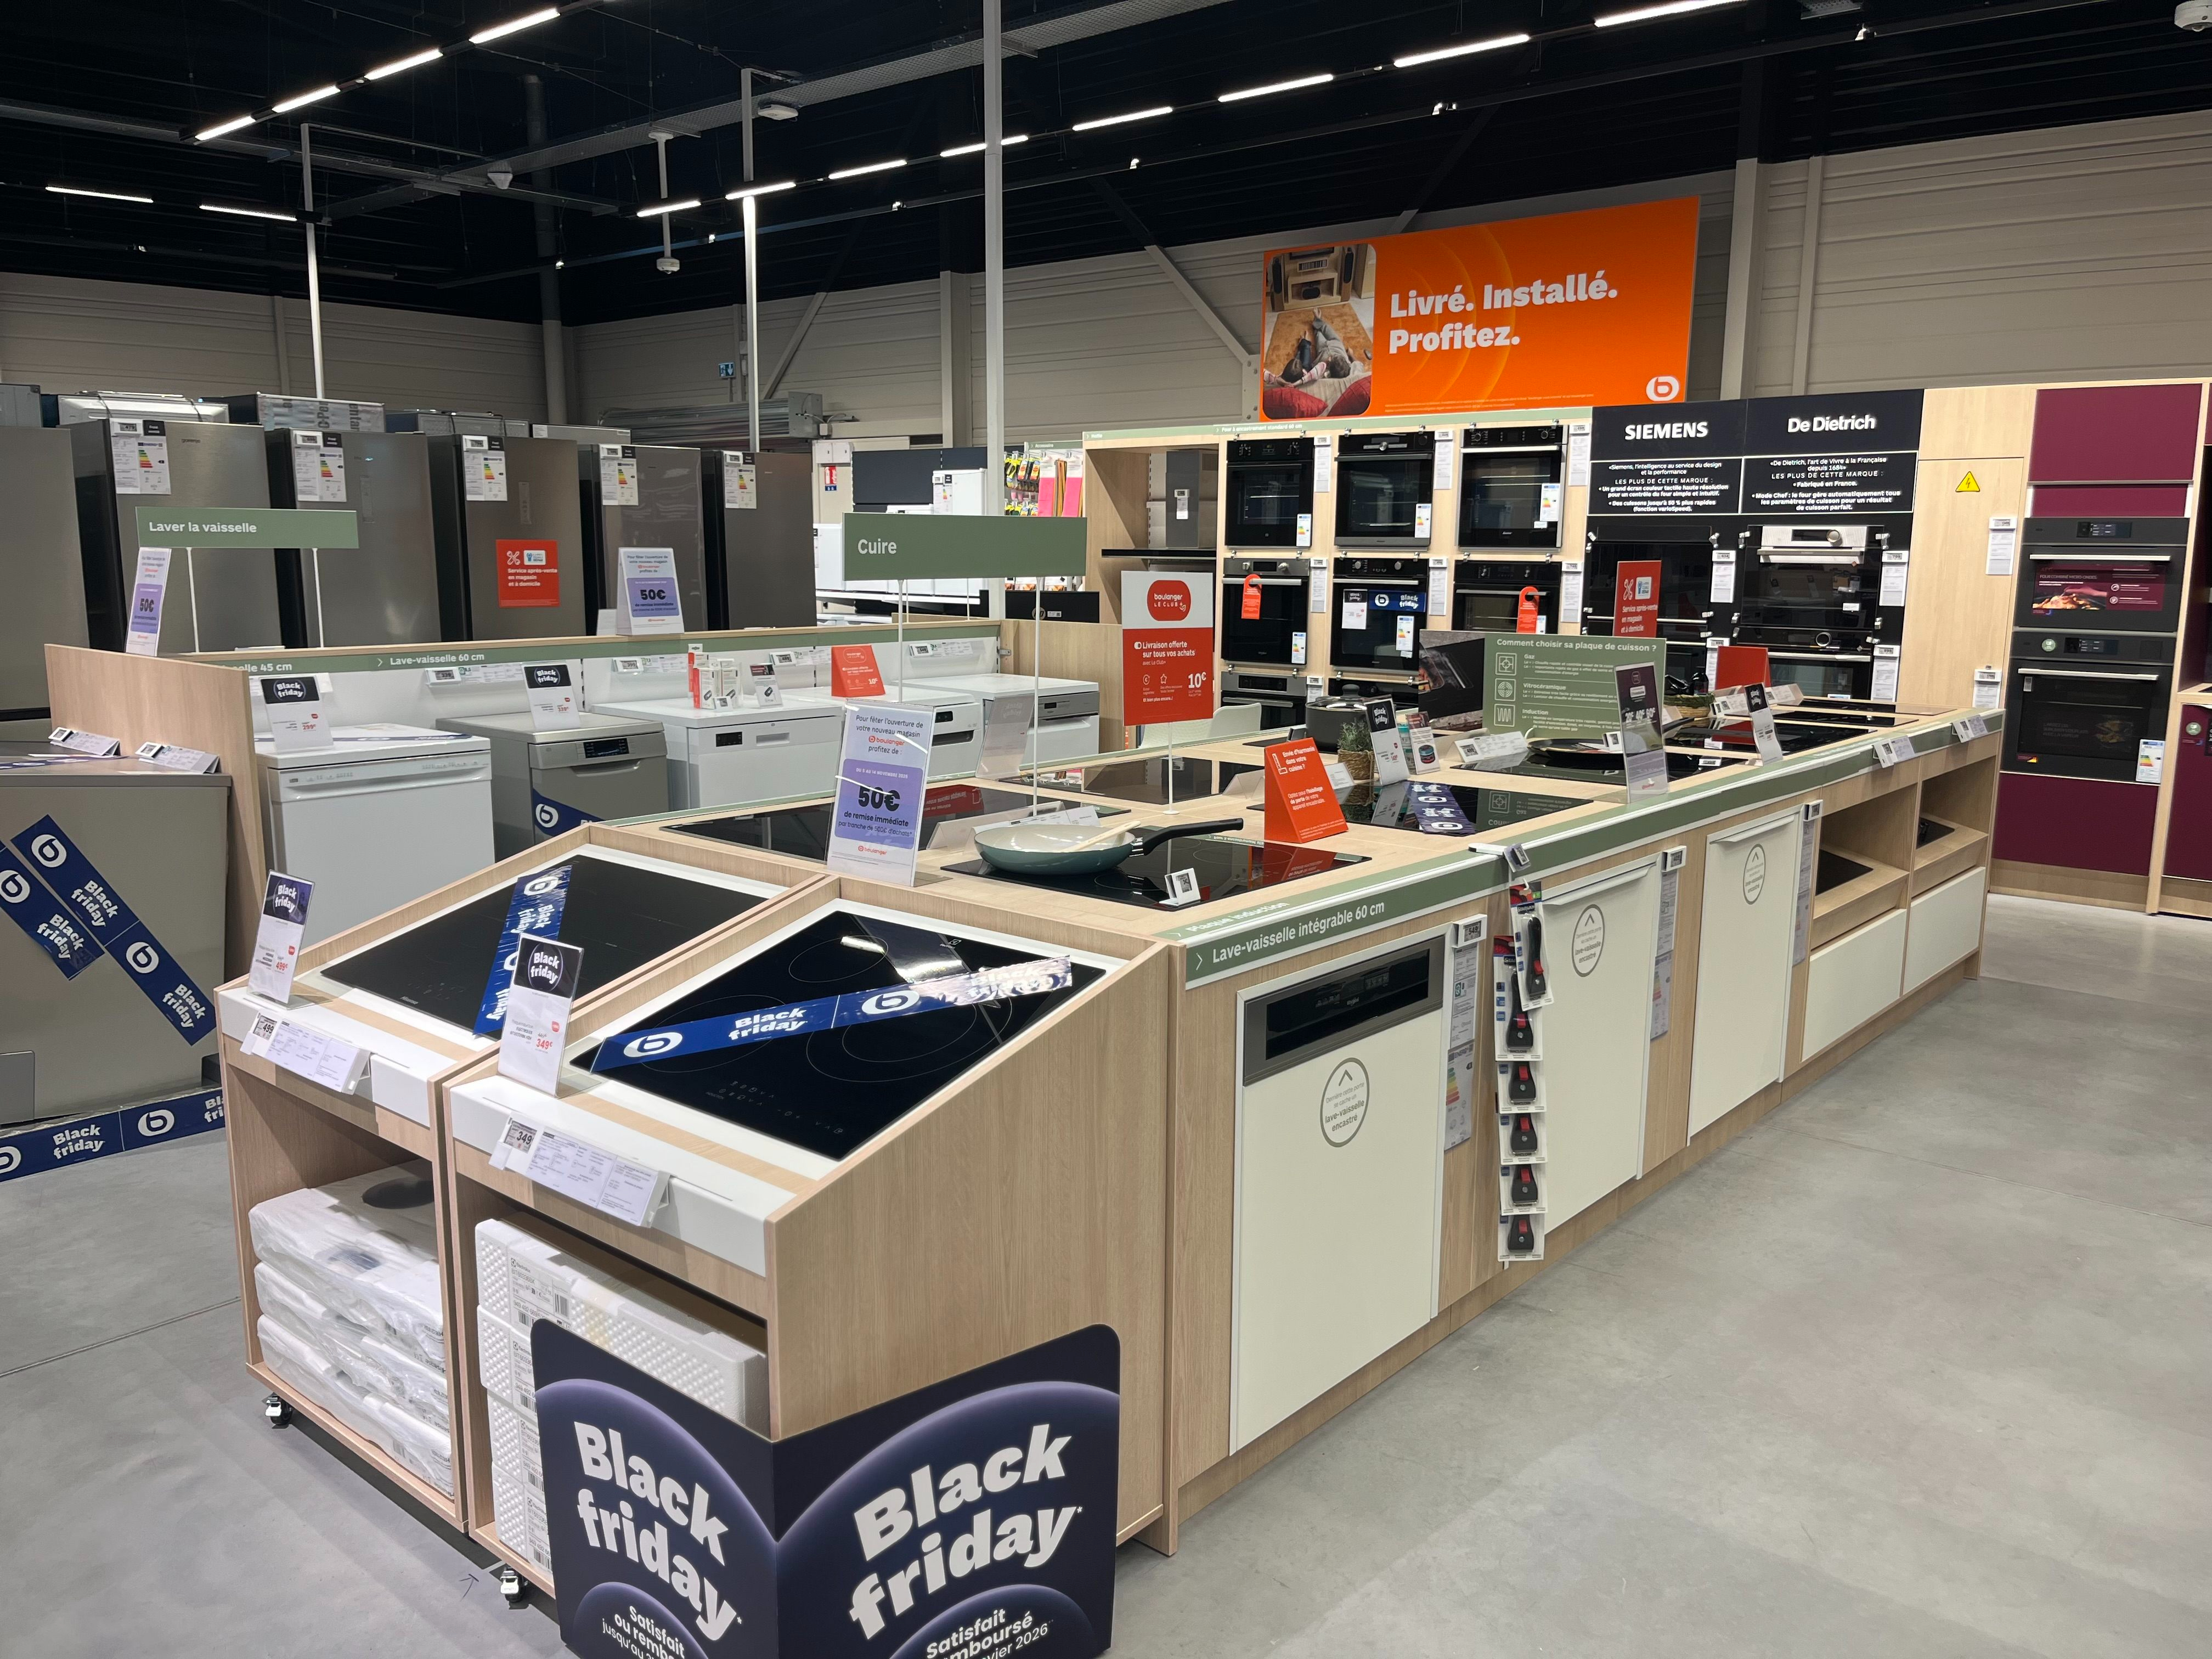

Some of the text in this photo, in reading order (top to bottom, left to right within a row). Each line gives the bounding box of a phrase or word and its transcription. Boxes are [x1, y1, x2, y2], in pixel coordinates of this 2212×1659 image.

[1391, 270, 1618, 318] Livré. Installé.
[1389, 323, 1520, 354] Profitez.
[1624, 422, 1708, 440] SIEMENS
[1787, 415, 1876, 433] De Dietrich
[149, 521, 257, 533] Laver la vaisselle
[857, 538, 897, 555] Cuire
[640, 589, 666, 600] 50€
[140, 599, 154, 612] 50€
[1575, 642, 1602, 650] plaque
[390, 655, 456, 665] Lave-vaisselle
[459, 653, 471, 662] 60
[1188, 672, 1206, 689] 10€
[885, 718, 915, 727] l'ouverture
[897, 729, 920, 737] magasin
[868, 746, 890, 754] profitez
[1294, 746, 1315, 755] d'harmonie
[858, 786, 900, 812] 50€
[848, 822, 866, 830] tranche
[853, 813, 873, 821] remise
[874, 814, 909, 827] immédiate
[84, 880, 119, 919] Black
[278, 884, 297, 899] Black
[70, 887, 107, 928] friday
[275, 896, 295, 913] friday
[1187, 901, 1289, 932] Plaque induction
[48, 913, 85, 951] Black
[1212, 901, 1384, 963] Lave-vaisselle intégrable 60 cm
[36, 922, 71, 961] friday
[276, 961, 288, 972] 499€
[533, 952, 560, 969] Black
[531, 966, 558, 984] friday
[162, 991, 195, 1030] friday
[174, 984, 205, 1020] Black
[735, 1008, 806, 1028] Black
[263, 1024, 274, 1034] 499
[729, 1021, 808, 1040] friday
[536, 1039, 553, 1049] 349€
[1325, 1099, 1365, 1124] lave-vaisselle
[1332, 1113, 1357, 1131] encastré
[53, 1124, 101, 1146] Black
[517, 1131, 532, 1145] 349
[53, 1139, 105, 1160] friday
[574, 1421, 729, 1567] Black
[852, 1424, 1074, 1562] Black
[614, 1614, 630, 1634] ou
[630, 1606, 685, 1659] Satisfait
[927, 1609, 1006, 1658] Satisfait
